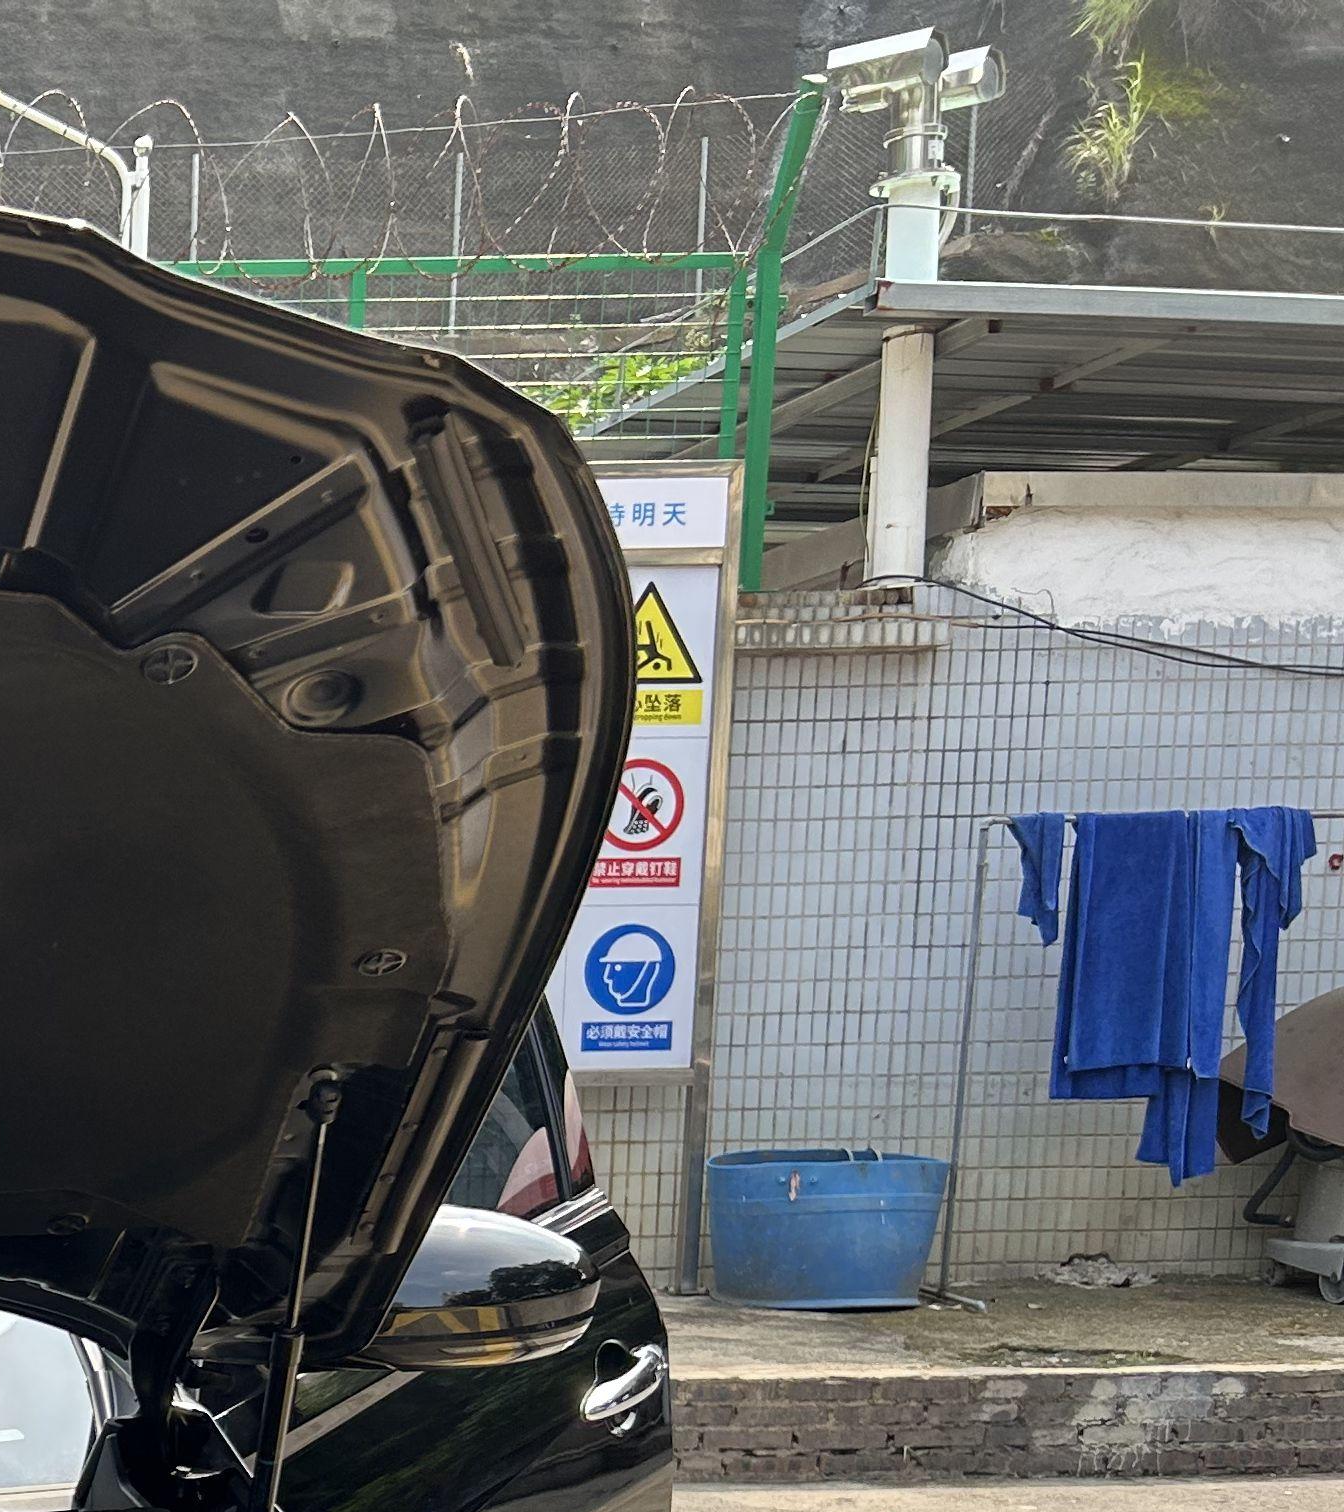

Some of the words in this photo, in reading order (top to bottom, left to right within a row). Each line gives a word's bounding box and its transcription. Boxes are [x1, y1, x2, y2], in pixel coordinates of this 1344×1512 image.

[586, 1024, 669, 1040] 必须戴安全帽
